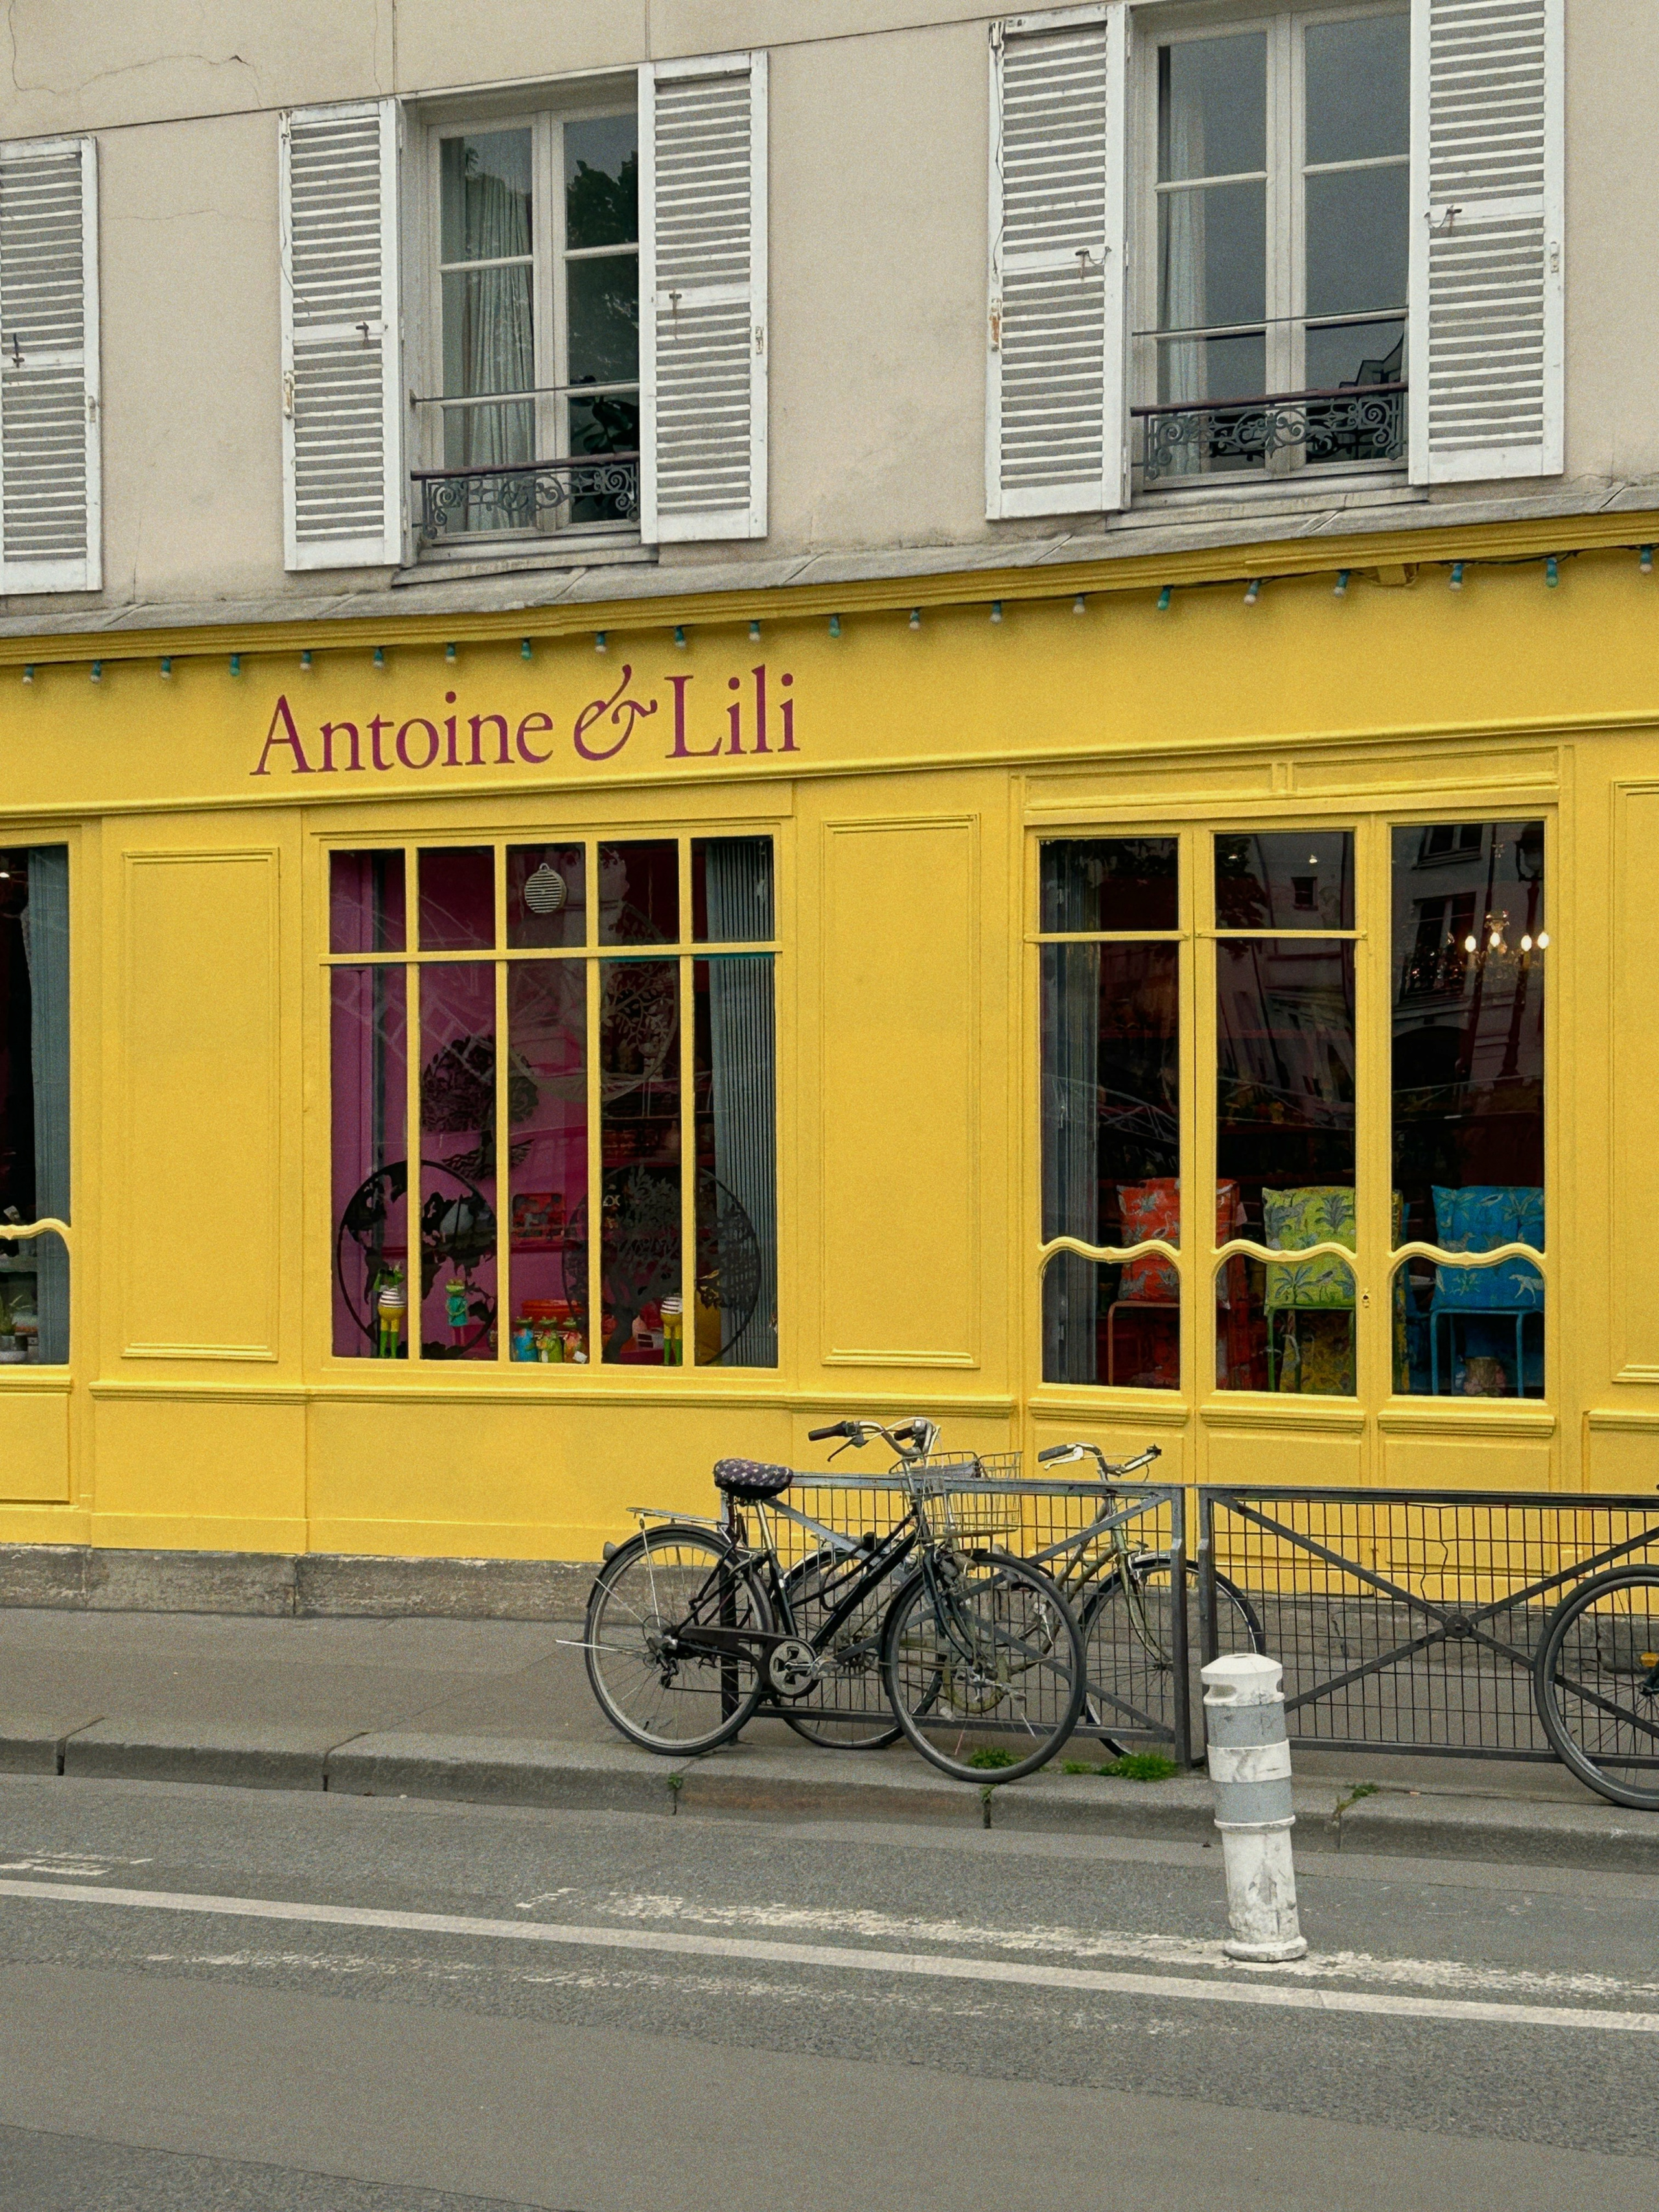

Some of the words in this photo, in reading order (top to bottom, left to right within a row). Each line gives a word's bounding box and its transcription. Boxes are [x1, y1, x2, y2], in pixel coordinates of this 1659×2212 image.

[249, 691, 553, 775] Antoine
[574, 664, 657, 761] &
[664, 664, 800, 759] Lili
